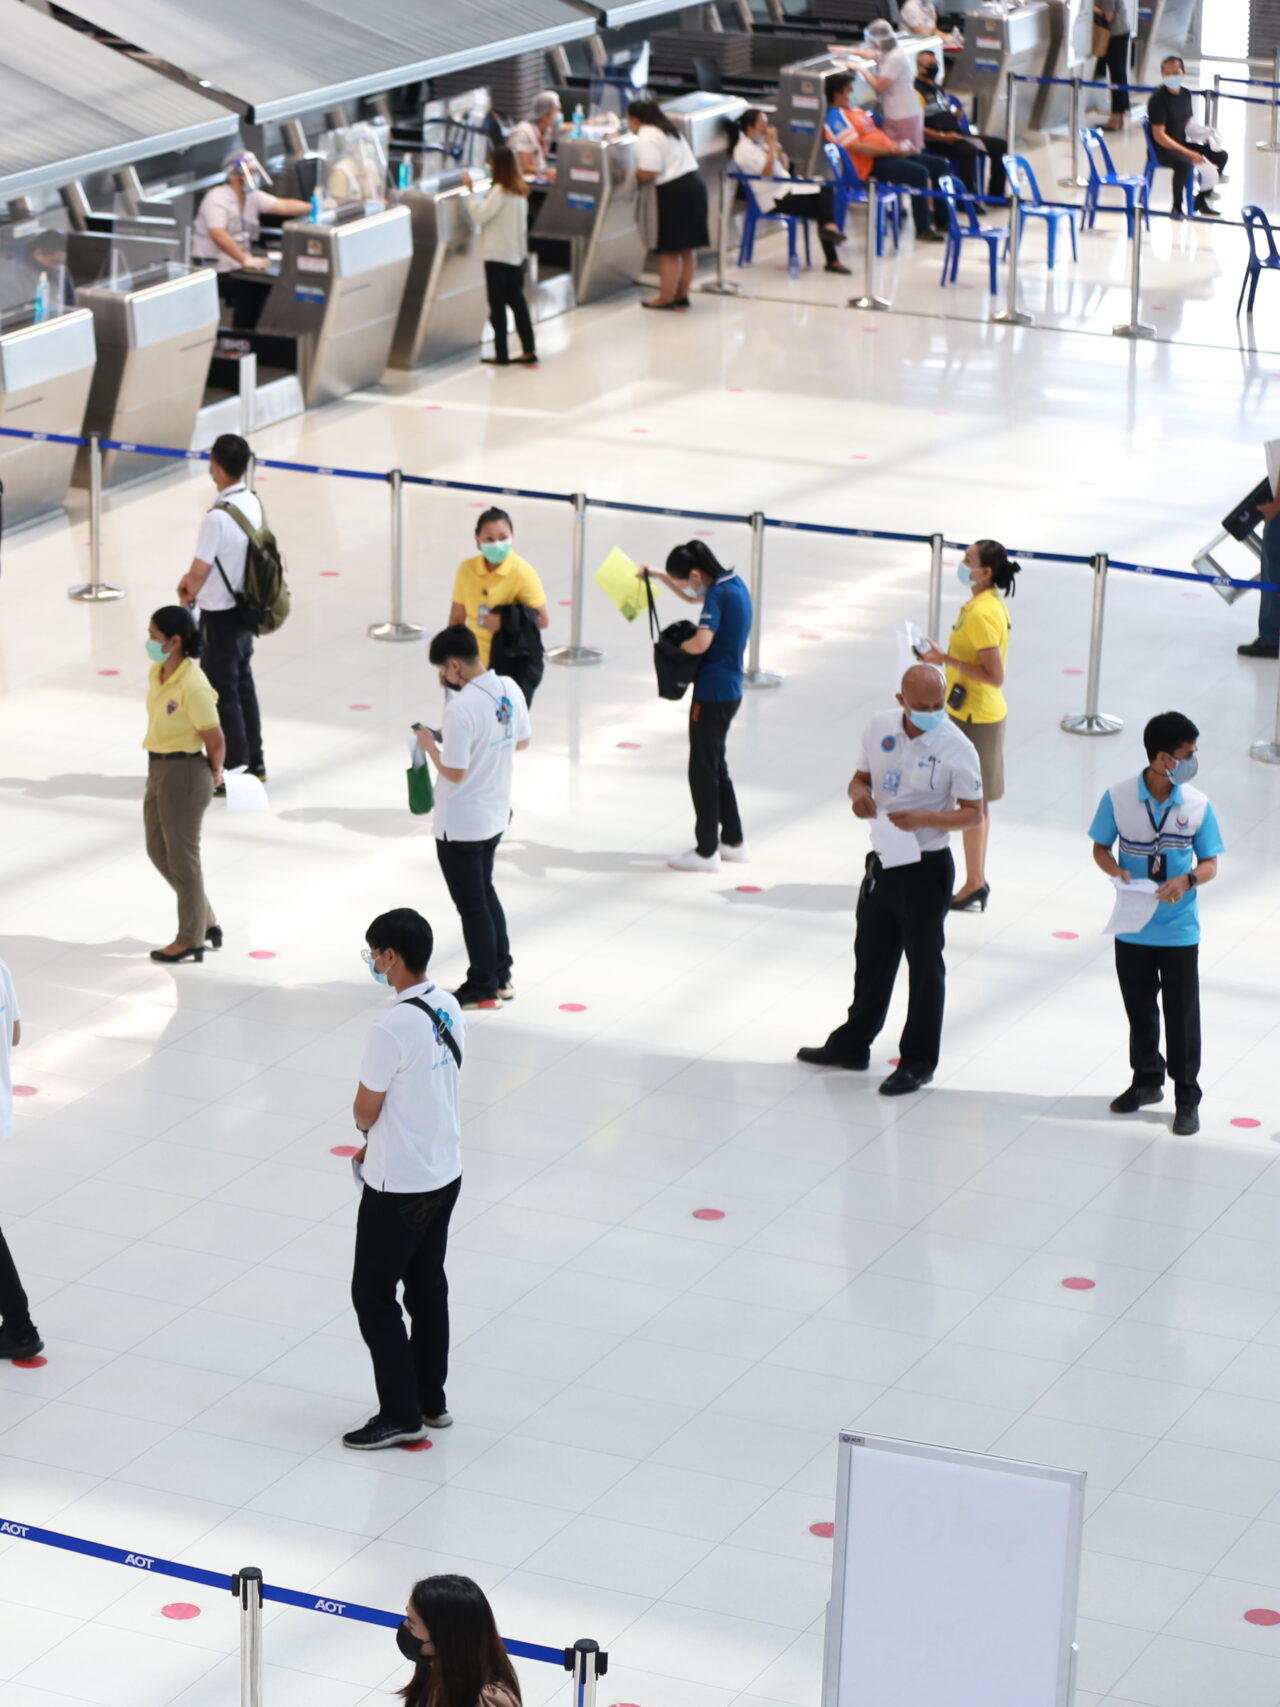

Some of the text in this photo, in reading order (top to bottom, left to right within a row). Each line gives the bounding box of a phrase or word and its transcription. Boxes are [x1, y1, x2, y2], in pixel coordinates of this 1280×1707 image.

[0, 1521, 30, 1538] AOT
[124, 1553, 155, 1570] AOT
[314, 1598, 346, 1616] AOT
